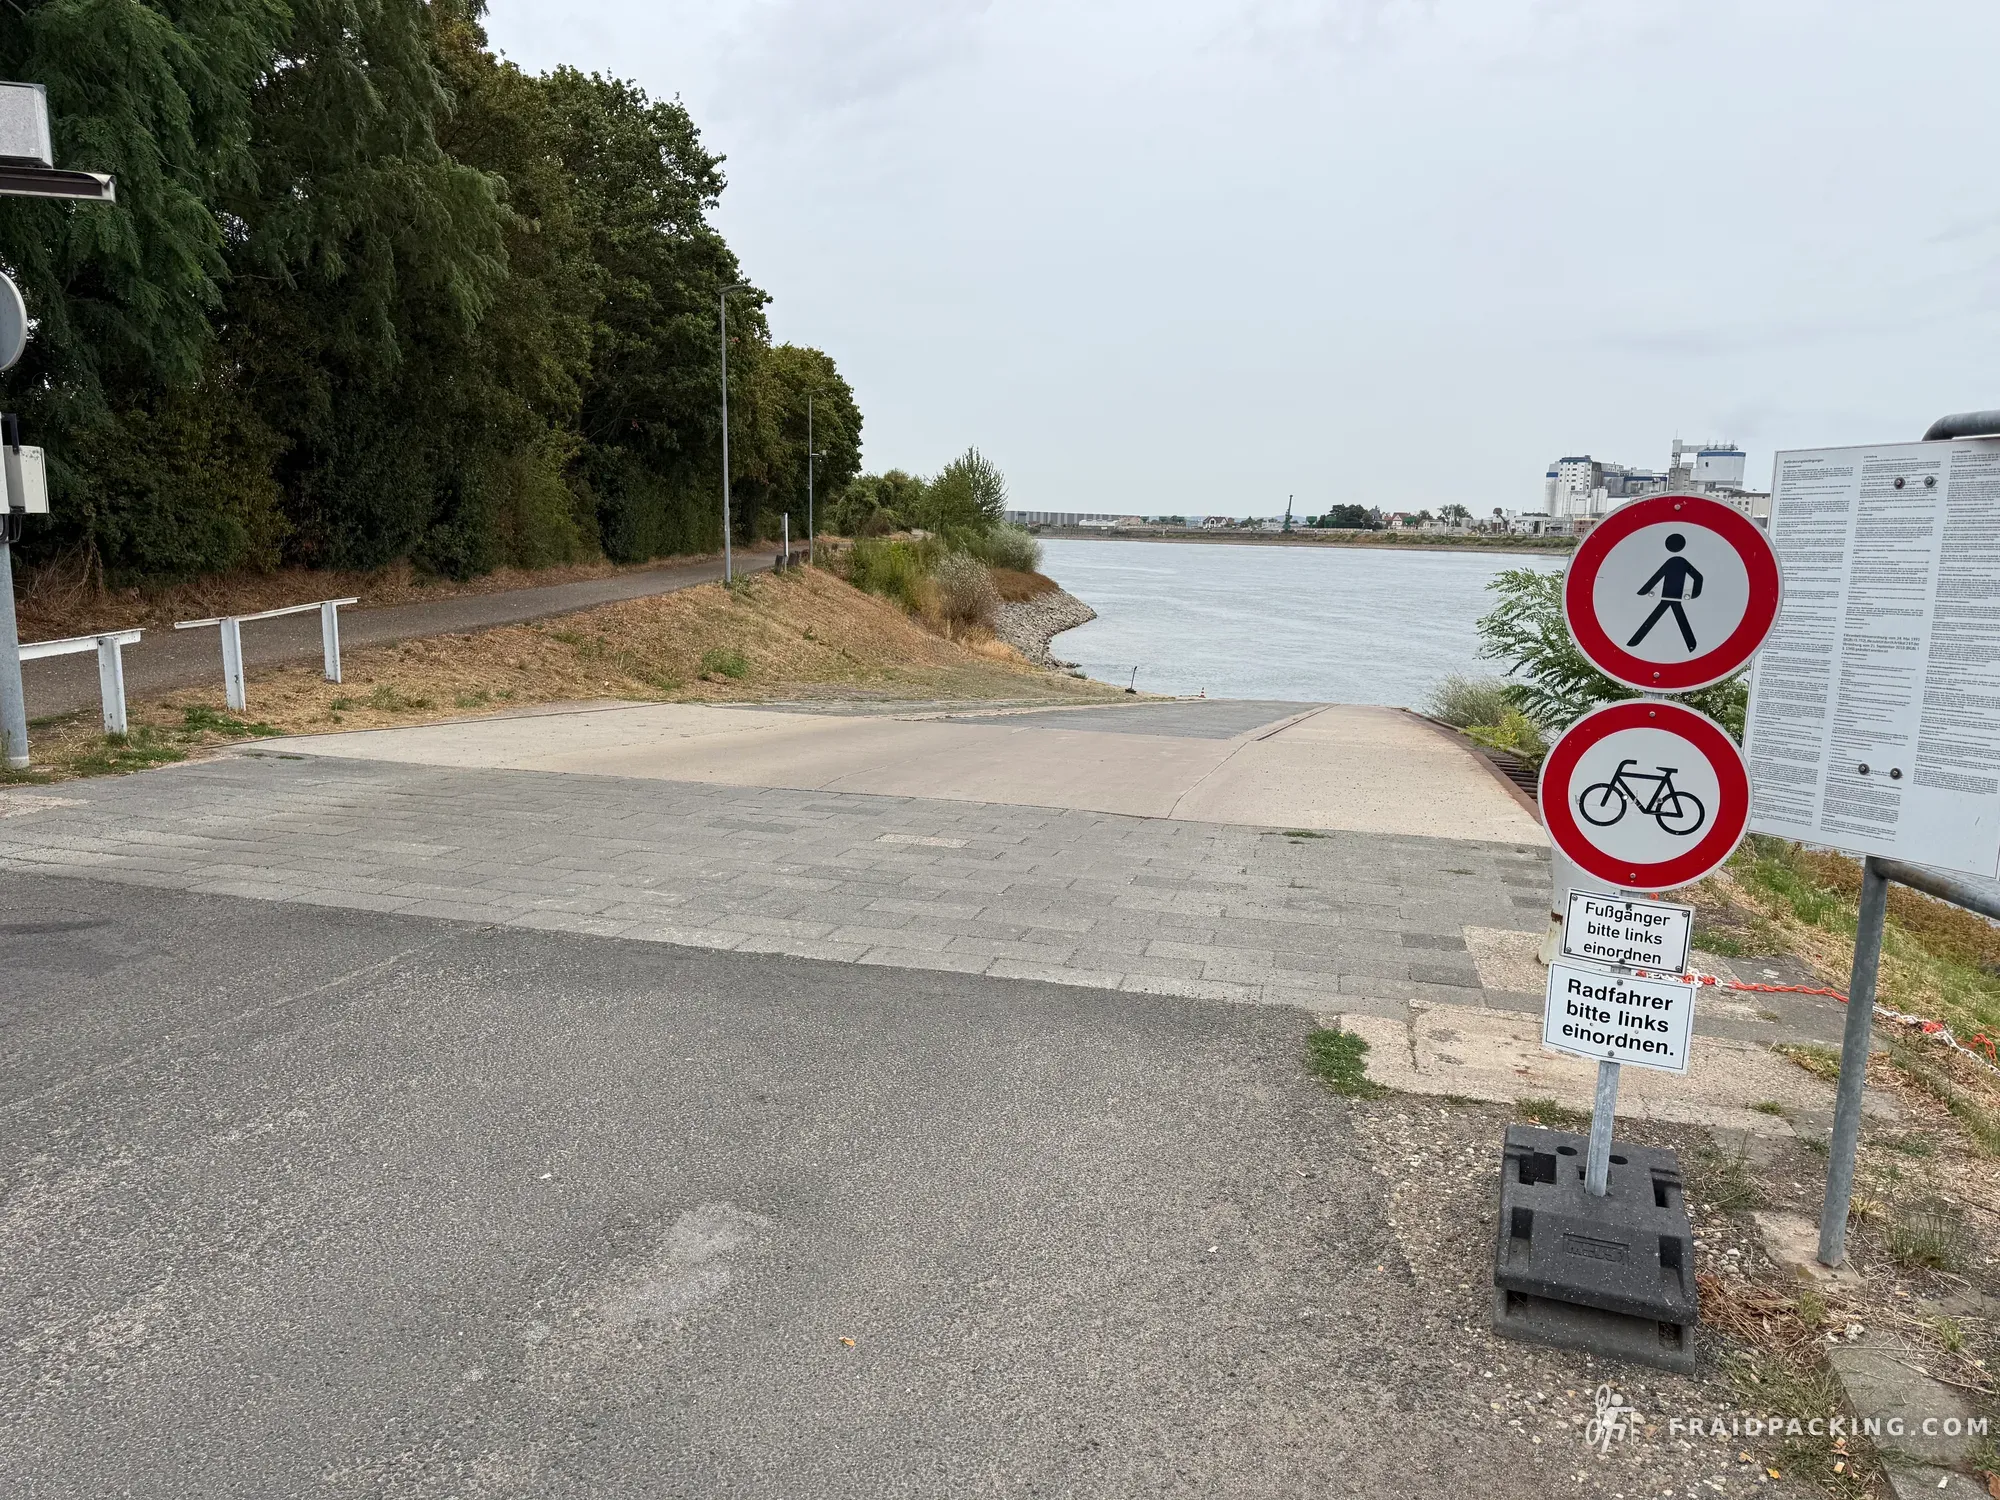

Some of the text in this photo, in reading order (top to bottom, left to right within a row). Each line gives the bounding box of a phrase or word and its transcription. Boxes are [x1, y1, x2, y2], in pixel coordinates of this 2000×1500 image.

[1585, 901, 1670, 927] Fußgänger
[1587, 921, 1662, 945] bitte links
[1583, 942, 1662, 964] einordnen
[1567, 978, 1673, 1011] Radfahrer
[1566, 1000, 1669, 1033] bitte links
[1562, 1023, 1675, 1056] einordnen.
